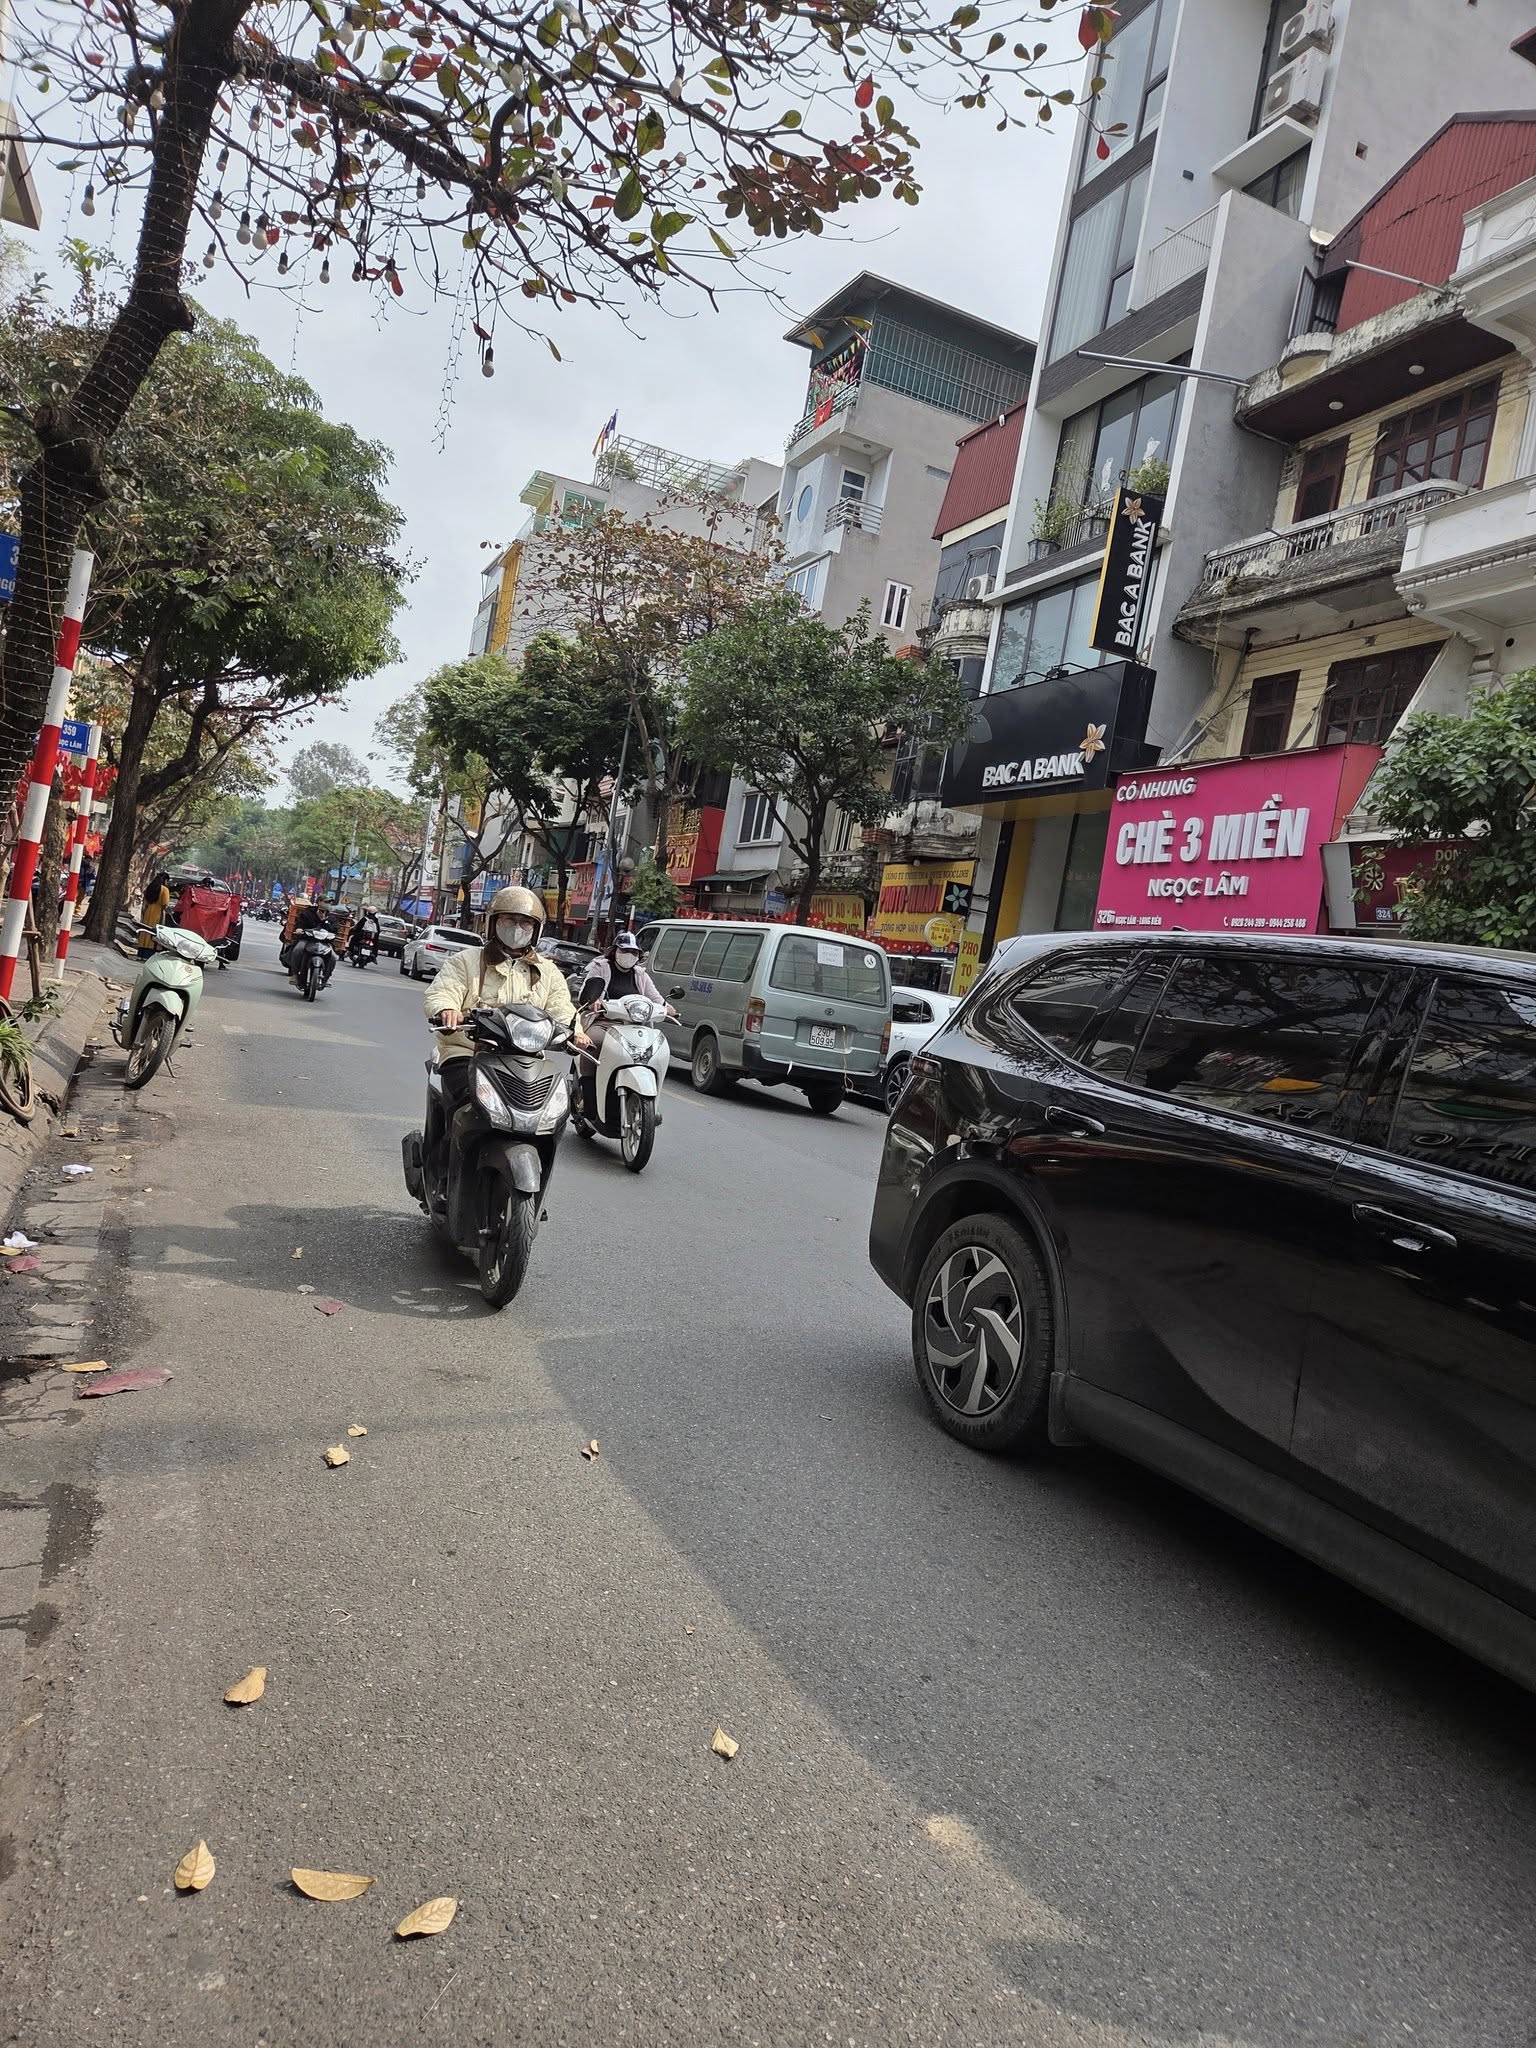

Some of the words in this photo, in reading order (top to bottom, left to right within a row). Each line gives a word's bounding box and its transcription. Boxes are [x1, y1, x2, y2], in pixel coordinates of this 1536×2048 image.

[9, 545, 20, 565] 3
[1126, 517, 1152, 579] BANK
[1124, 584, 1141, 600] A
[1114, 601, 1136, 646] BAC
[62, 724, 77, 736] 359
[982, 762, 1018, 787] BAC
[1017, 760, 1032, 782] A
[1033, 752, 1085, 780] BANK
[1116, 781, 1139, 802] CÔ
[1138, 777, 1197, 800] NHUNG
[1116, 810, 1176, 865] CHÈ
[1180, 817, 1204, 862] 3
[1208, 794, 1310, 861] MIỀN
[1147, 878, 1203, 904] NGỌC
[1204, 871, 1249, 896] LÂM
[1377, 909, 1391, 919] 324
[961, 941, 979, 957] PHO
[961, 963, 972, 977] TO
